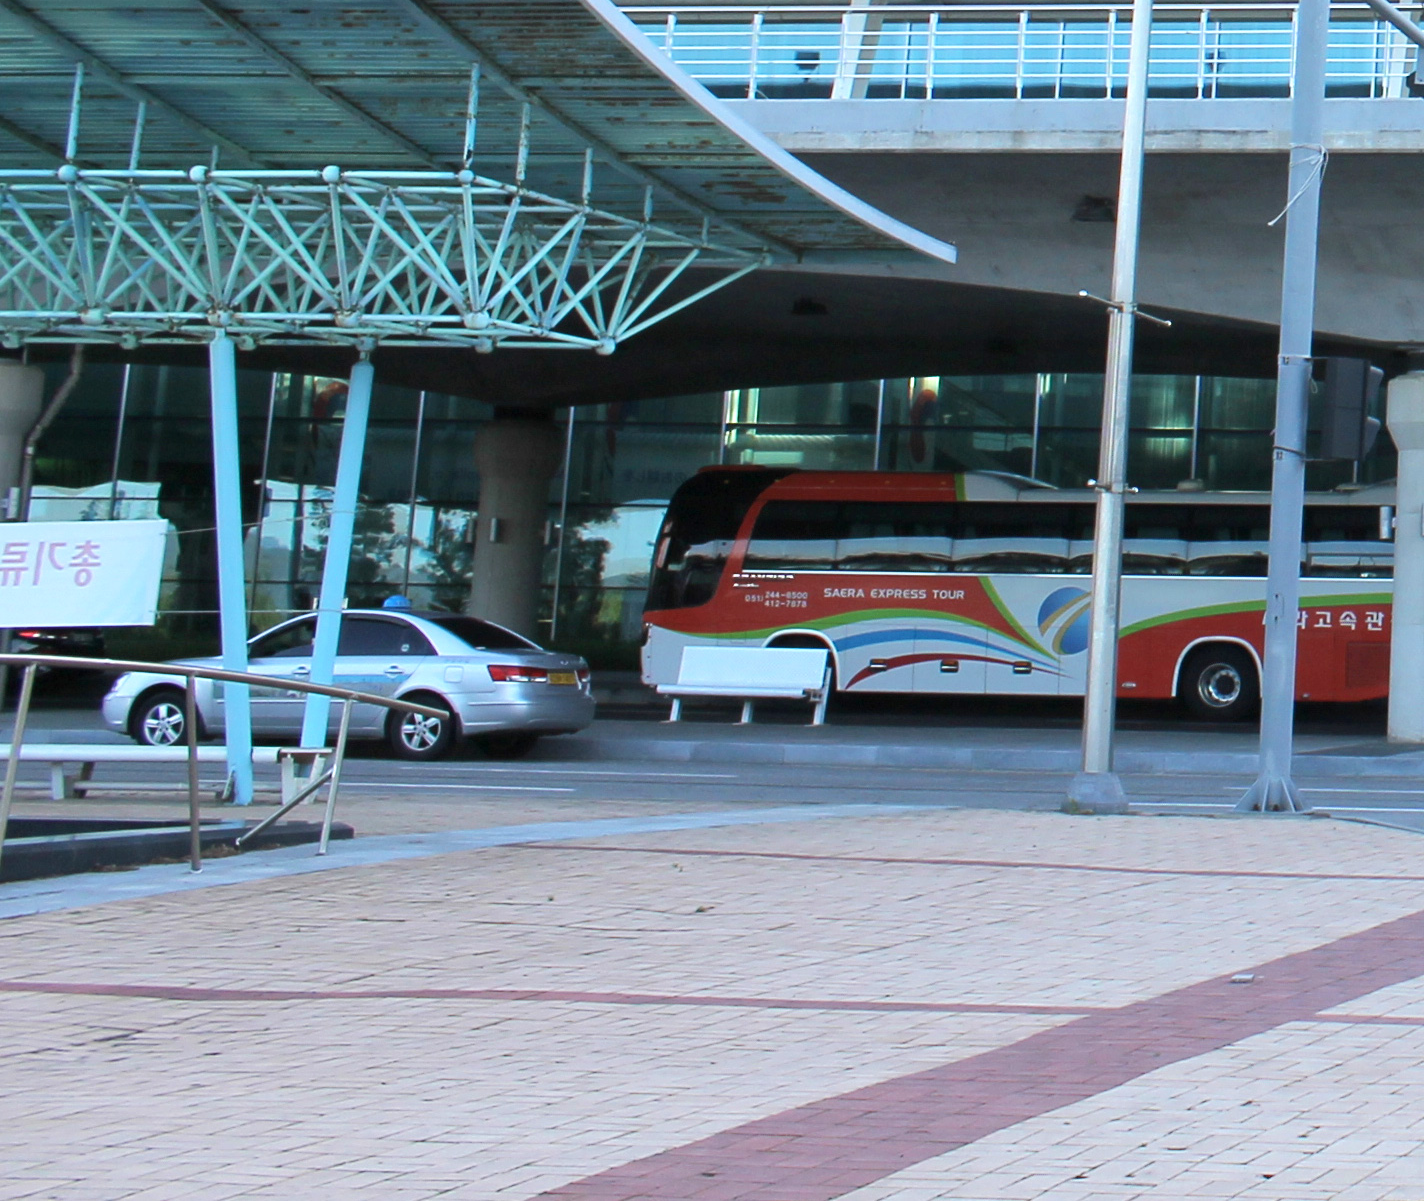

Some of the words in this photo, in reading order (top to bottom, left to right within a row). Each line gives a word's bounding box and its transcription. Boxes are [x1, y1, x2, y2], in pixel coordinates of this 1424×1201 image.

[824, 587, 865, 598] SAERA
[870, 588, 927, 599] EXPRESS
[932, 589, 965, 600] TOUR
